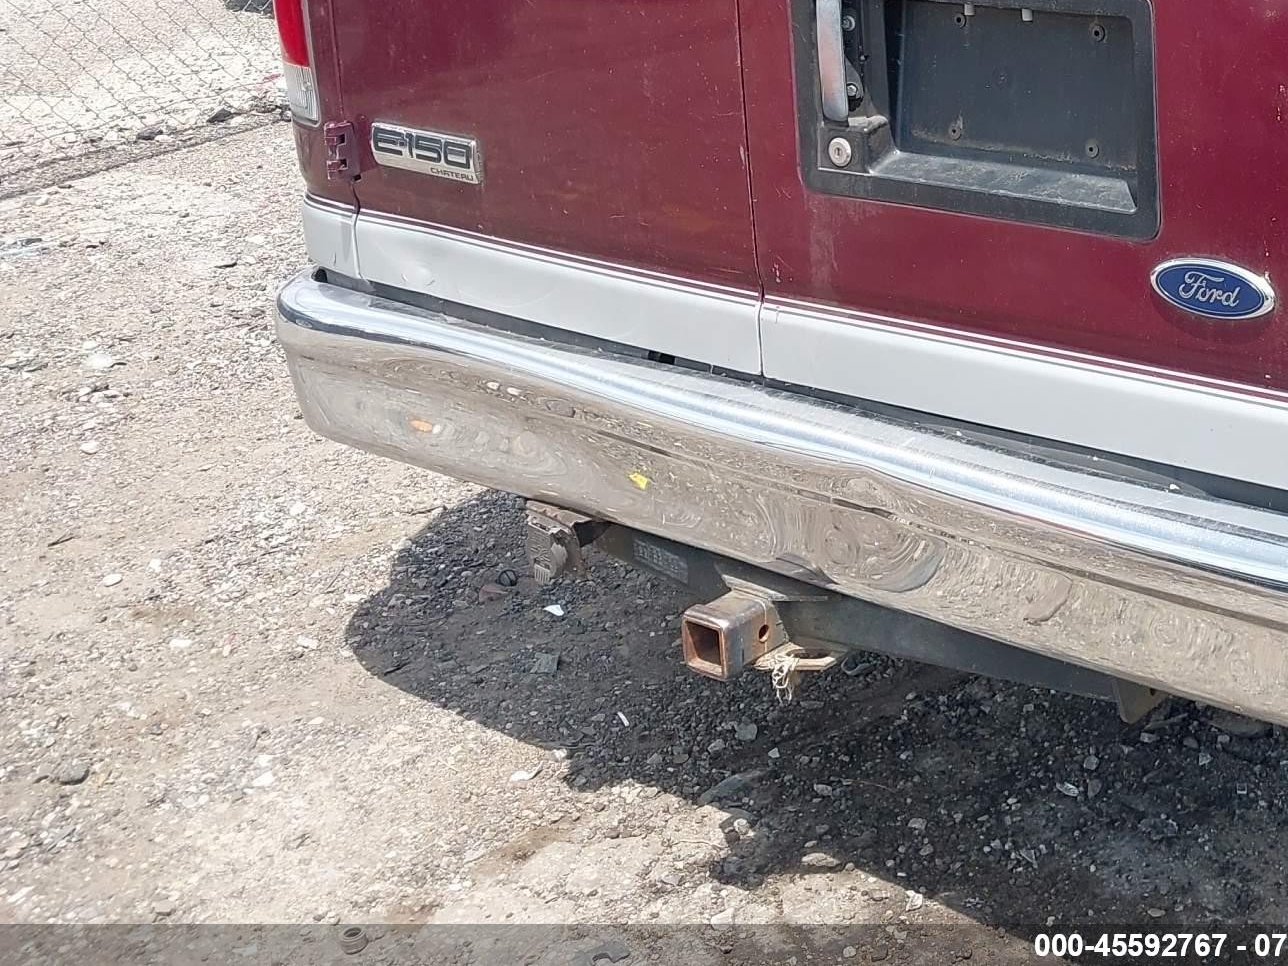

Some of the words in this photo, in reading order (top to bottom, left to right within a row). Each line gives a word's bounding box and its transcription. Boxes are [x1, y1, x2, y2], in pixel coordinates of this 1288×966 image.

[373, 127, 472, 170] E-150
[430, 167, 474, 181] CHATEAU
[1178, 270, 1241, 307] Ford
